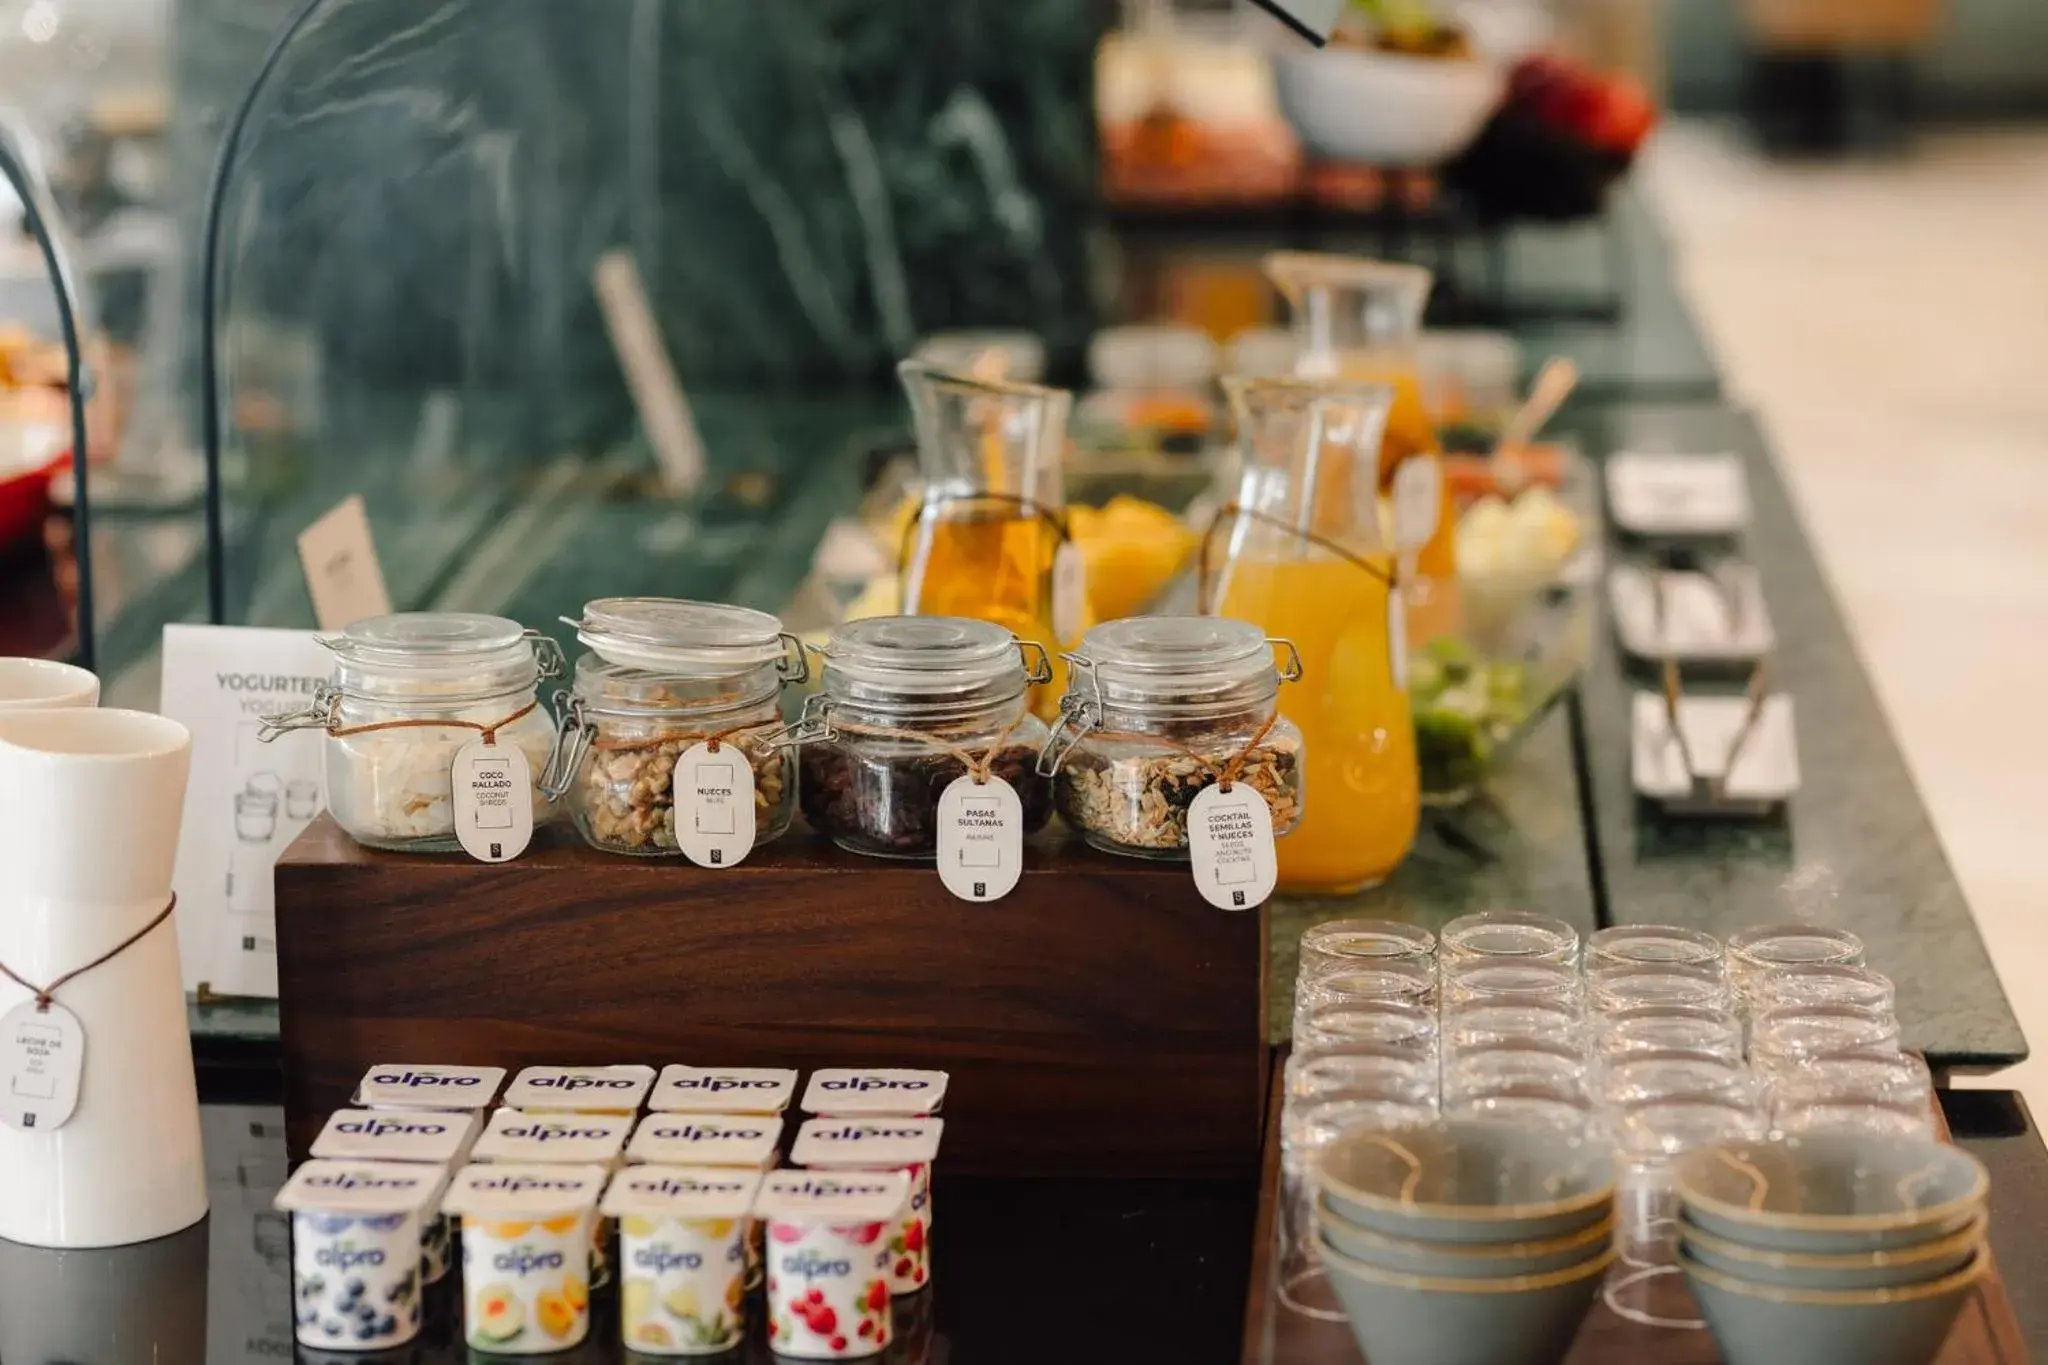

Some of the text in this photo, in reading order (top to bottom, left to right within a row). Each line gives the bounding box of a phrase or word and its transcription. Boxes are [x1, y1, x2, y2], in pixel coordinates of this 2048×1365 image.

[479, 771, 504, 779] COCO
[472, 780, 511, 788] RALLADO
[697, 788, 732, 796] NUECES
[958, 819, 1003, 827] SULTANAS
[1208, 813, 1251, 822] COCKTAIL
[1209, 821, 1253, 832] SEMILLAS
[1218, 831, 1253, 840] NUECES
[373, 1072, 481, 1087] alpro
[528, 1075, 636, 1091] alpro
[673, 1076, 780, 1092] alpro
[821, 1076, 929, 1091] alpro
[335, 1119, 446, 1136] alpro
[500, 1124, 611, 1141] alpro
[653, 1126, 762, 1141] alpro
[812, 1127, 923, 1140] alpro
[470, 1174, 583, 1192] alpro
[315, 1241, 386, 1272] alpro
[493, 1246, 564, 1275] alpro
[633, 1246, 703, 1274] alpro
[781, 1250, 852, 1280] alpro
